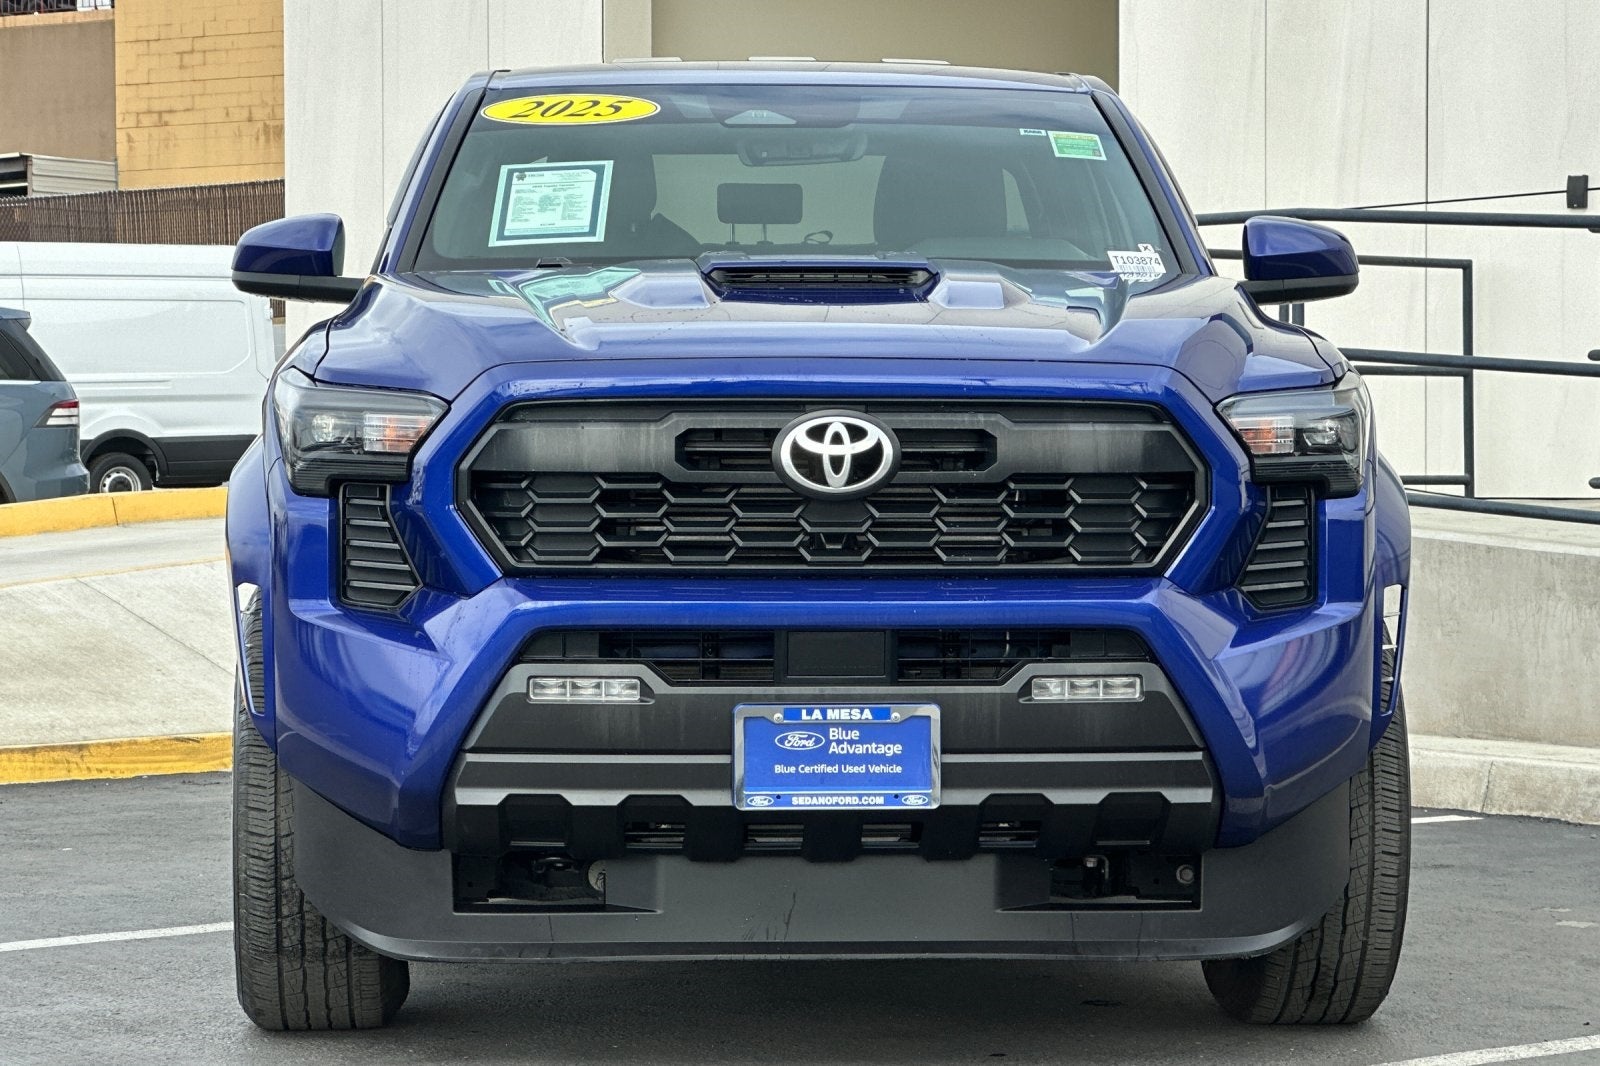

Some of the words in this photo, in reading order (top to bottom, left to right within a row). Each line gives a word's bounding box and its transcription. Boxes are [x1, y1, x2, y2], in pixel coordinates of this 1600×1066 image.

[509, 99, 633, 118] 2025
[1112, 255, 1161, 266] T103874
[801, 708, 823, 720] LA
[826, 708, 873, 720] MESA
[829, 727, 860, 740] Blue
[783, 733, 816, 748] Ford
[828, 741, 903, 756] Advantage
[774, 764, 796, 774] Blue
[798, 764, 838, 774] Certified
[841, 764, 866, 774] Used
[868, 764, 903, 774] Vehicle
[791, 796, 885, 805] SEDANOFORD.COM
